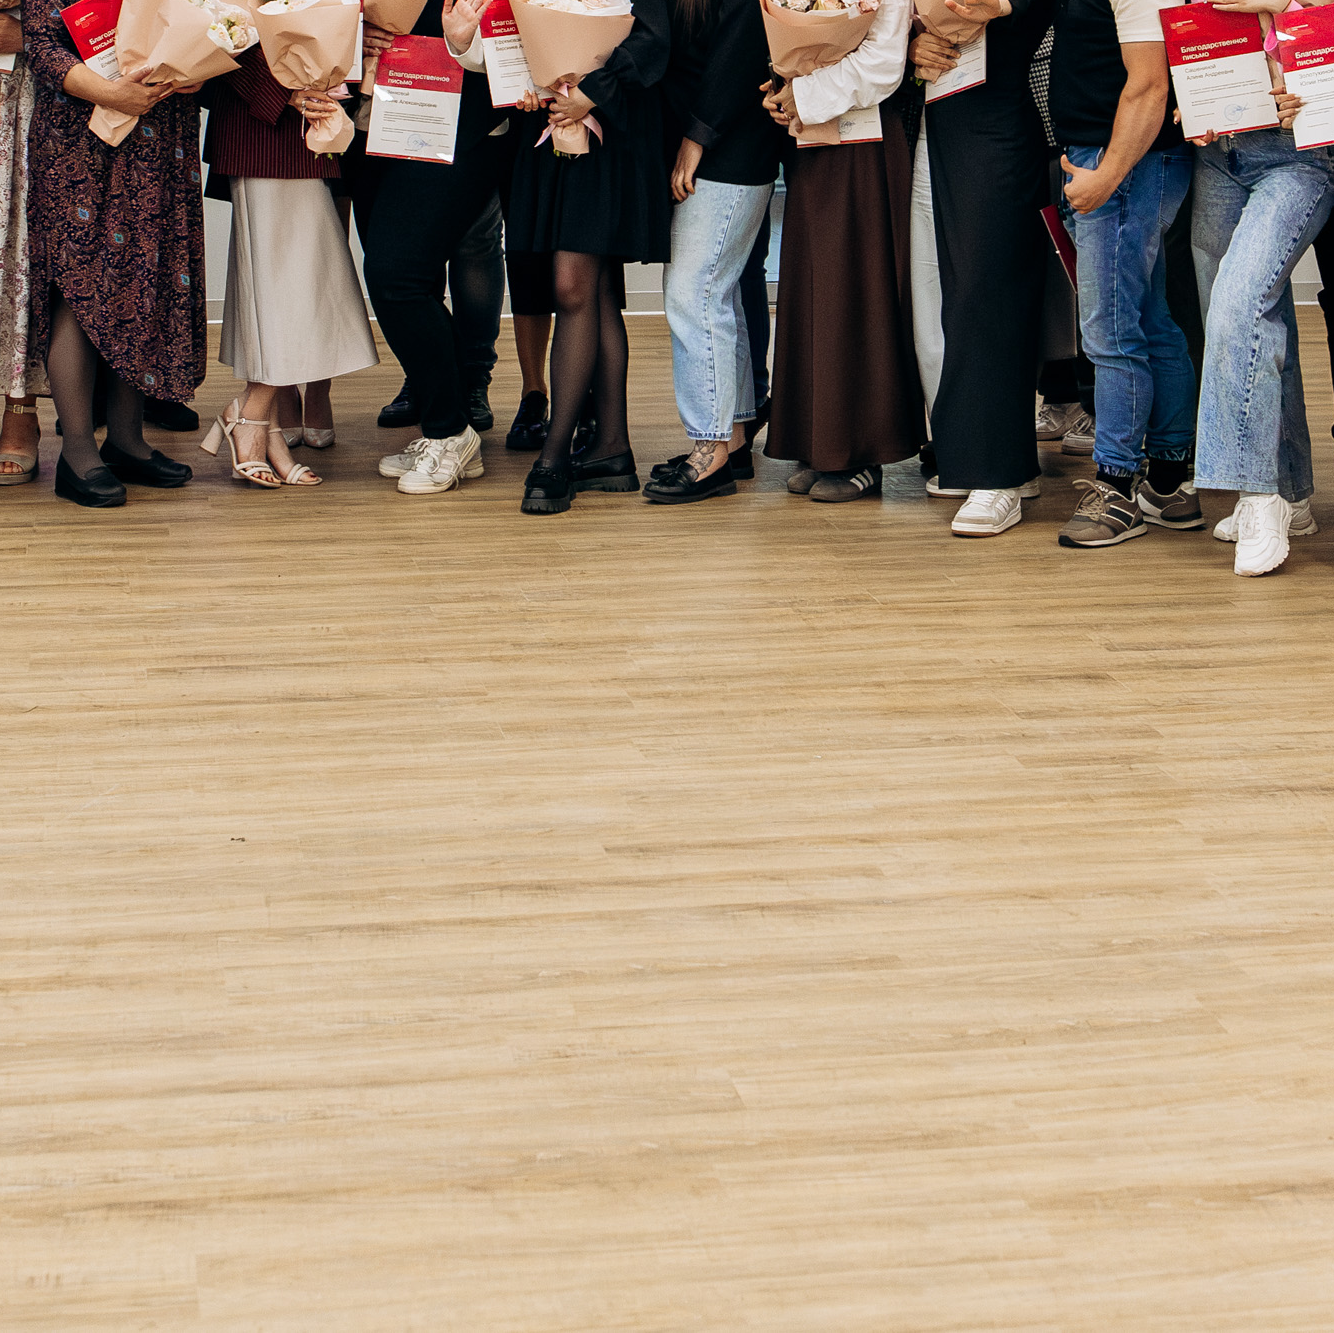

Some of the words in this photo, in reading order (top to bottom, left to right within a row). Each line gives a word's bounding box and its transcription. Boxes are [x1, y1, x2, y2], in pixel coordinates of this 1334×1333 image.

[1180, 36, 1248, 54] Благодарственное
[1182, 52, 1210, 61] письмо
[1296, 57, 1324, 67] письмо
[388, 70, 450, 82] Благодарственное
